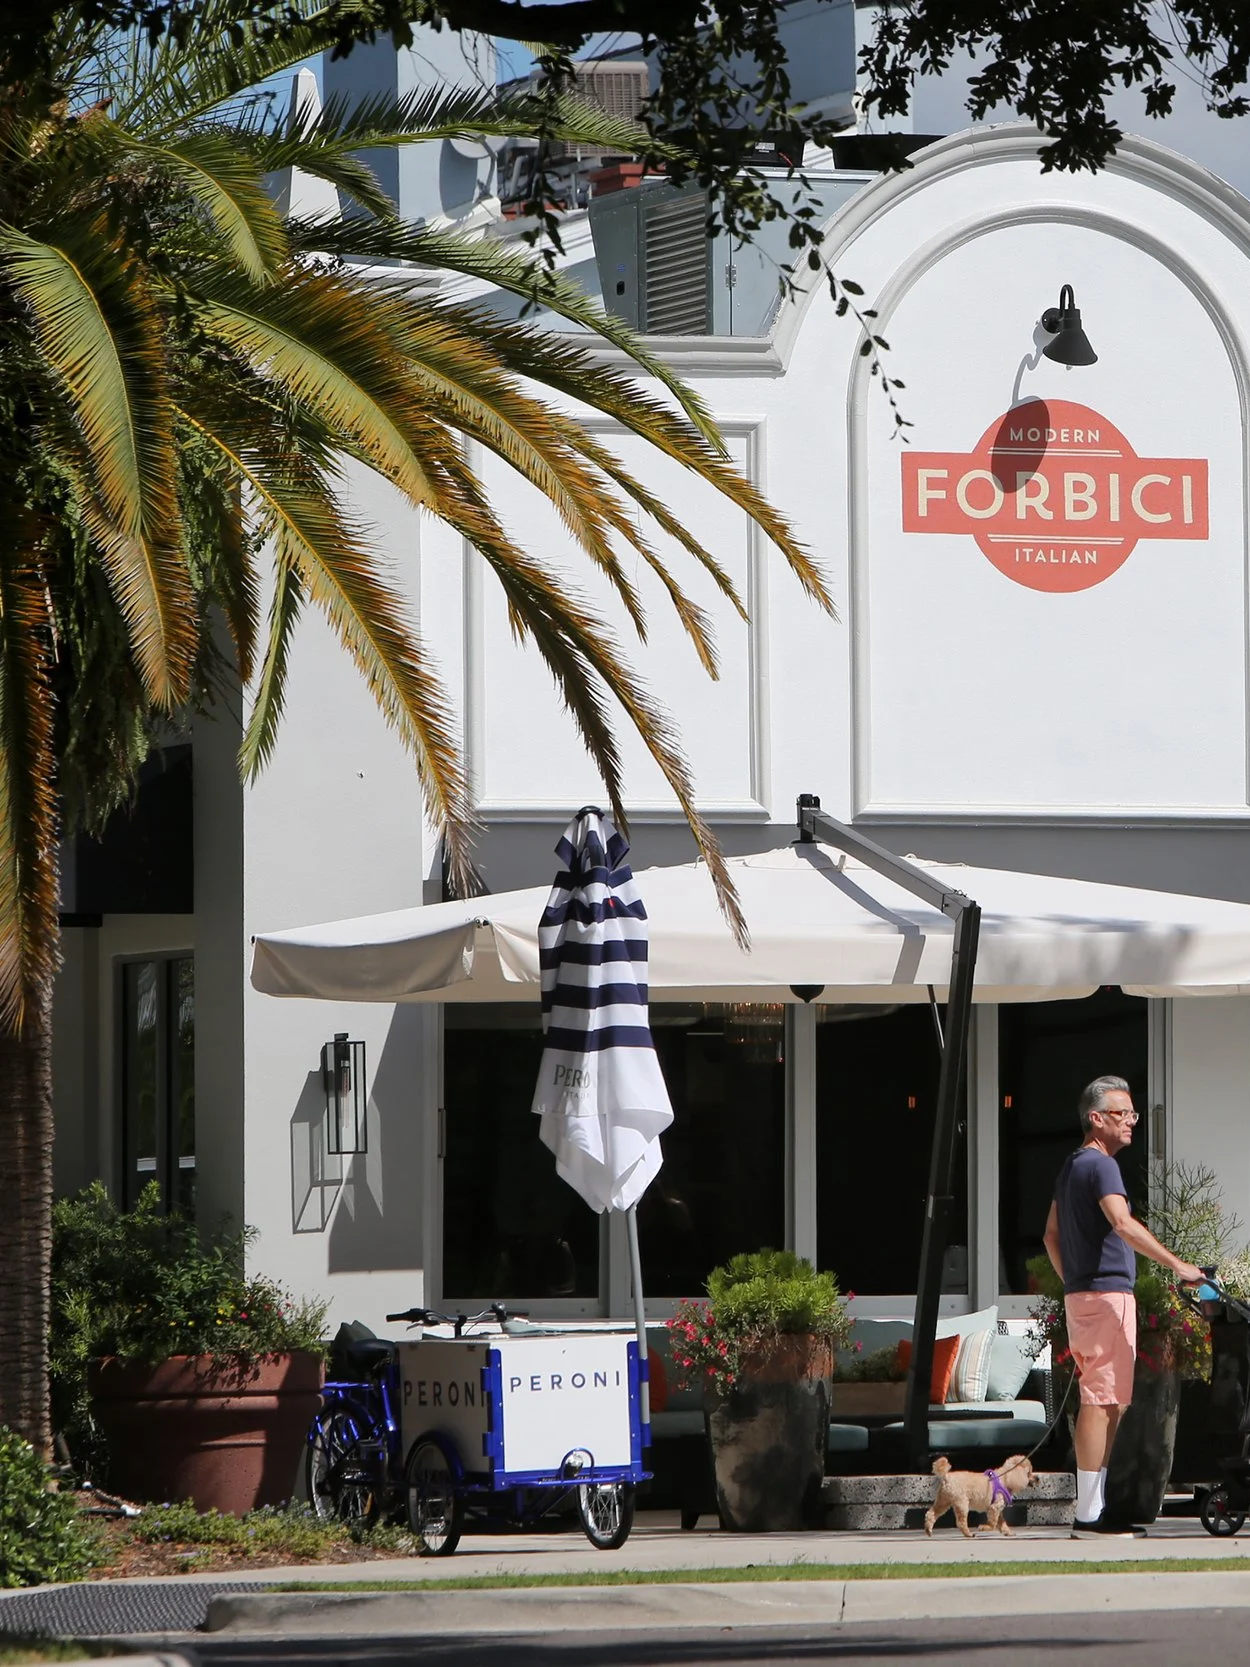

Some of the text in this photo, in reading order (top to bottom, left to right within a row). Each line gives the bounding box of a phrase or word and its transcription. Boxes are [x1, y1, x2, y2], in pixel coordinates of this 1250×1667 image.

[1009, 427, 1100, 443] MODERN
[917, 468, 1193, 524] FORBICI
[1015, 548, 1097, 564] ITALIAN
[510, 1370, 620, 1393] PERONI
